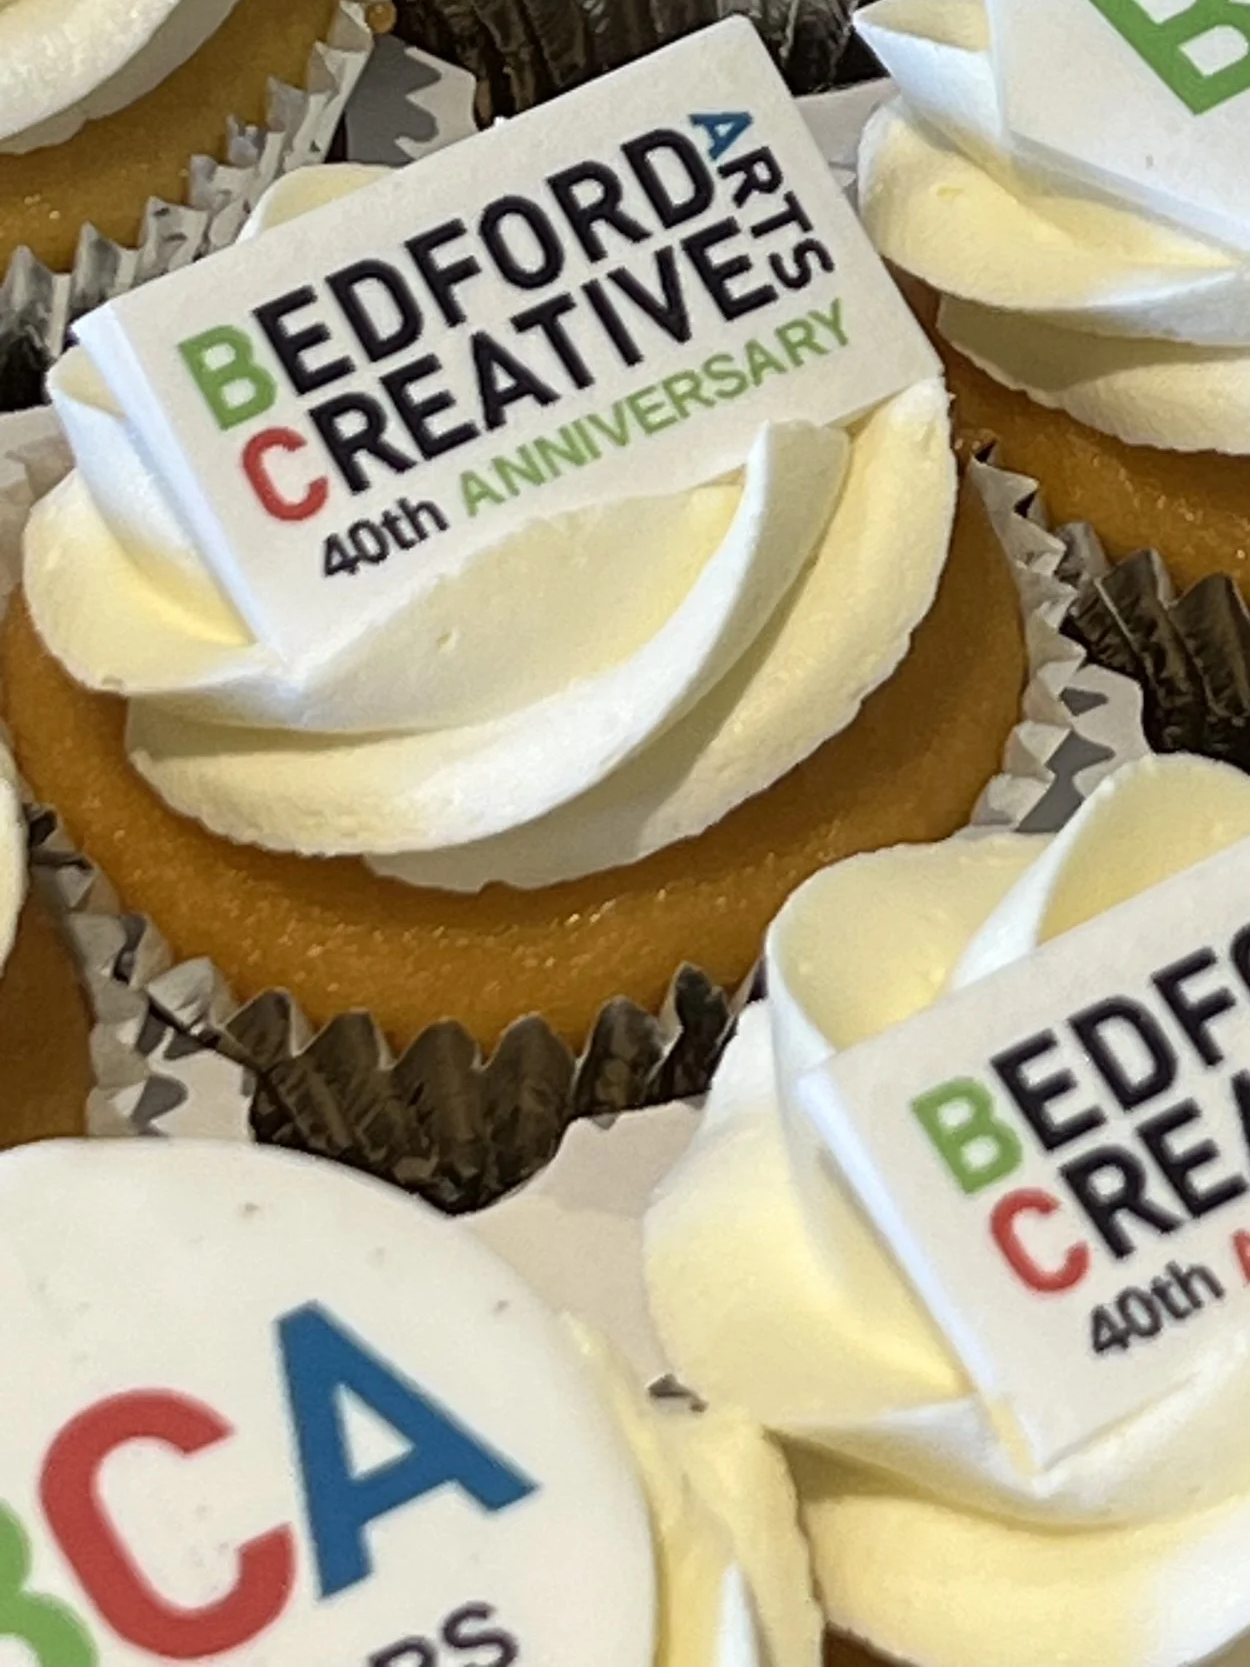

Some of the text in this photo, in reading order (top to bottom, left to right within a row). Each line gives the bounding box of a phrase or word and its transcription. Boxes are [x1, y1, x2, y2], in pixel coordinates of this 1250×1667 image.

[177, 126, 718, 433] BEDFORD
[689, 110, 835, 290] ARTS
[240, 215, 780, 522] CREATIVE
[322, 298, 851, 579] 40th ANNIVERSARY
[1088, 1261, 1226, 1358] 40th
